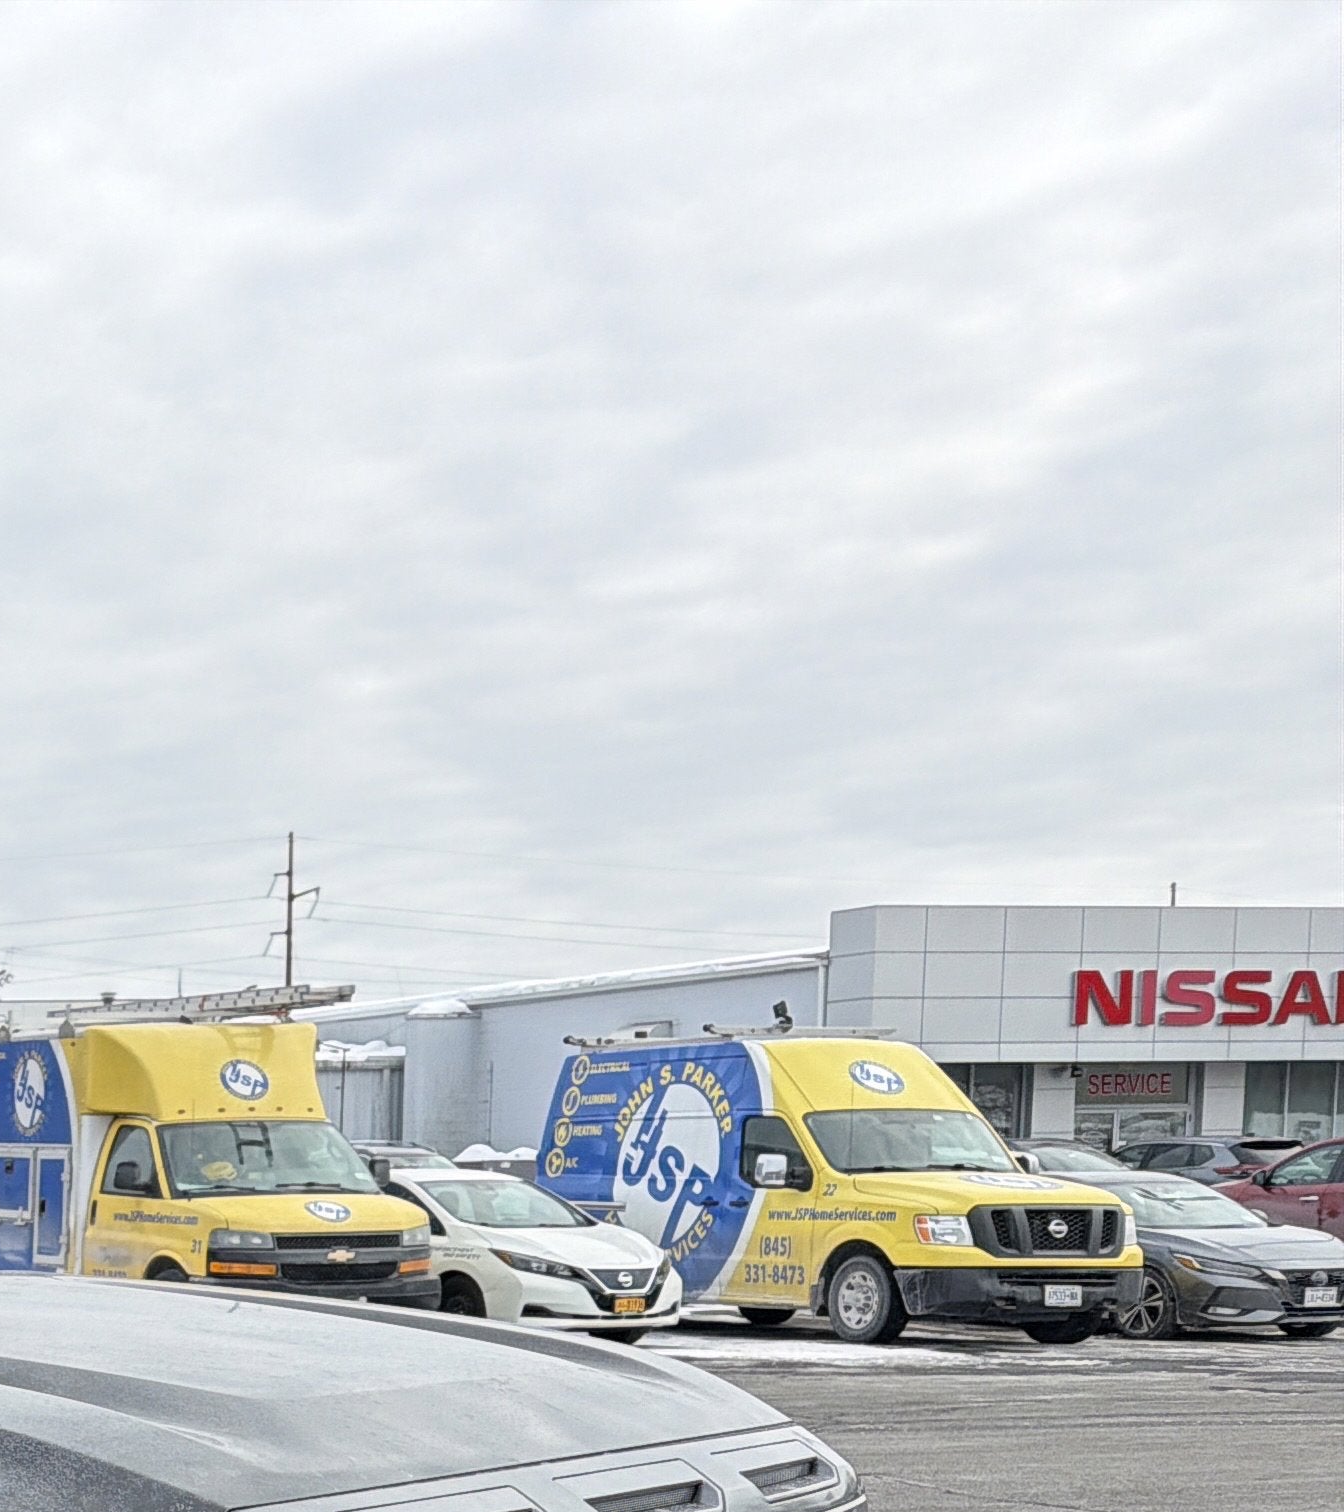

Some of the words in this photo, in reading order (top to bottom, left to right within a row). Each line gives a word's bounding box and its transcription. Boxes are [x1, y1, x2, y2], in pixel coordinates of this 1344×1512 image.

[1073, 969, 1344, 1026] NISSA
[588, 1060, 631, 1075] ELECTRICAL
[1088, 1072, 1172, 1096] SERVICE
[580, 1092, 618, 1106] PLUMBING
[614, 1075, 654, 1143] JOHN
[659, 1064, 676, 1086] S.
[681, 1061, 733, 1137] PARKER
[572, 1125, 603, 1137] HEATING
[822, 1183, 837, 1197] 22
[768, 1207, 897, 1222] www.JSPHomeServices.com
[666, 1207, 714, 1262] VICES
[759, 1235, 793, 1259] (845)
[744, 1263, 805, 1285] 331-8473
